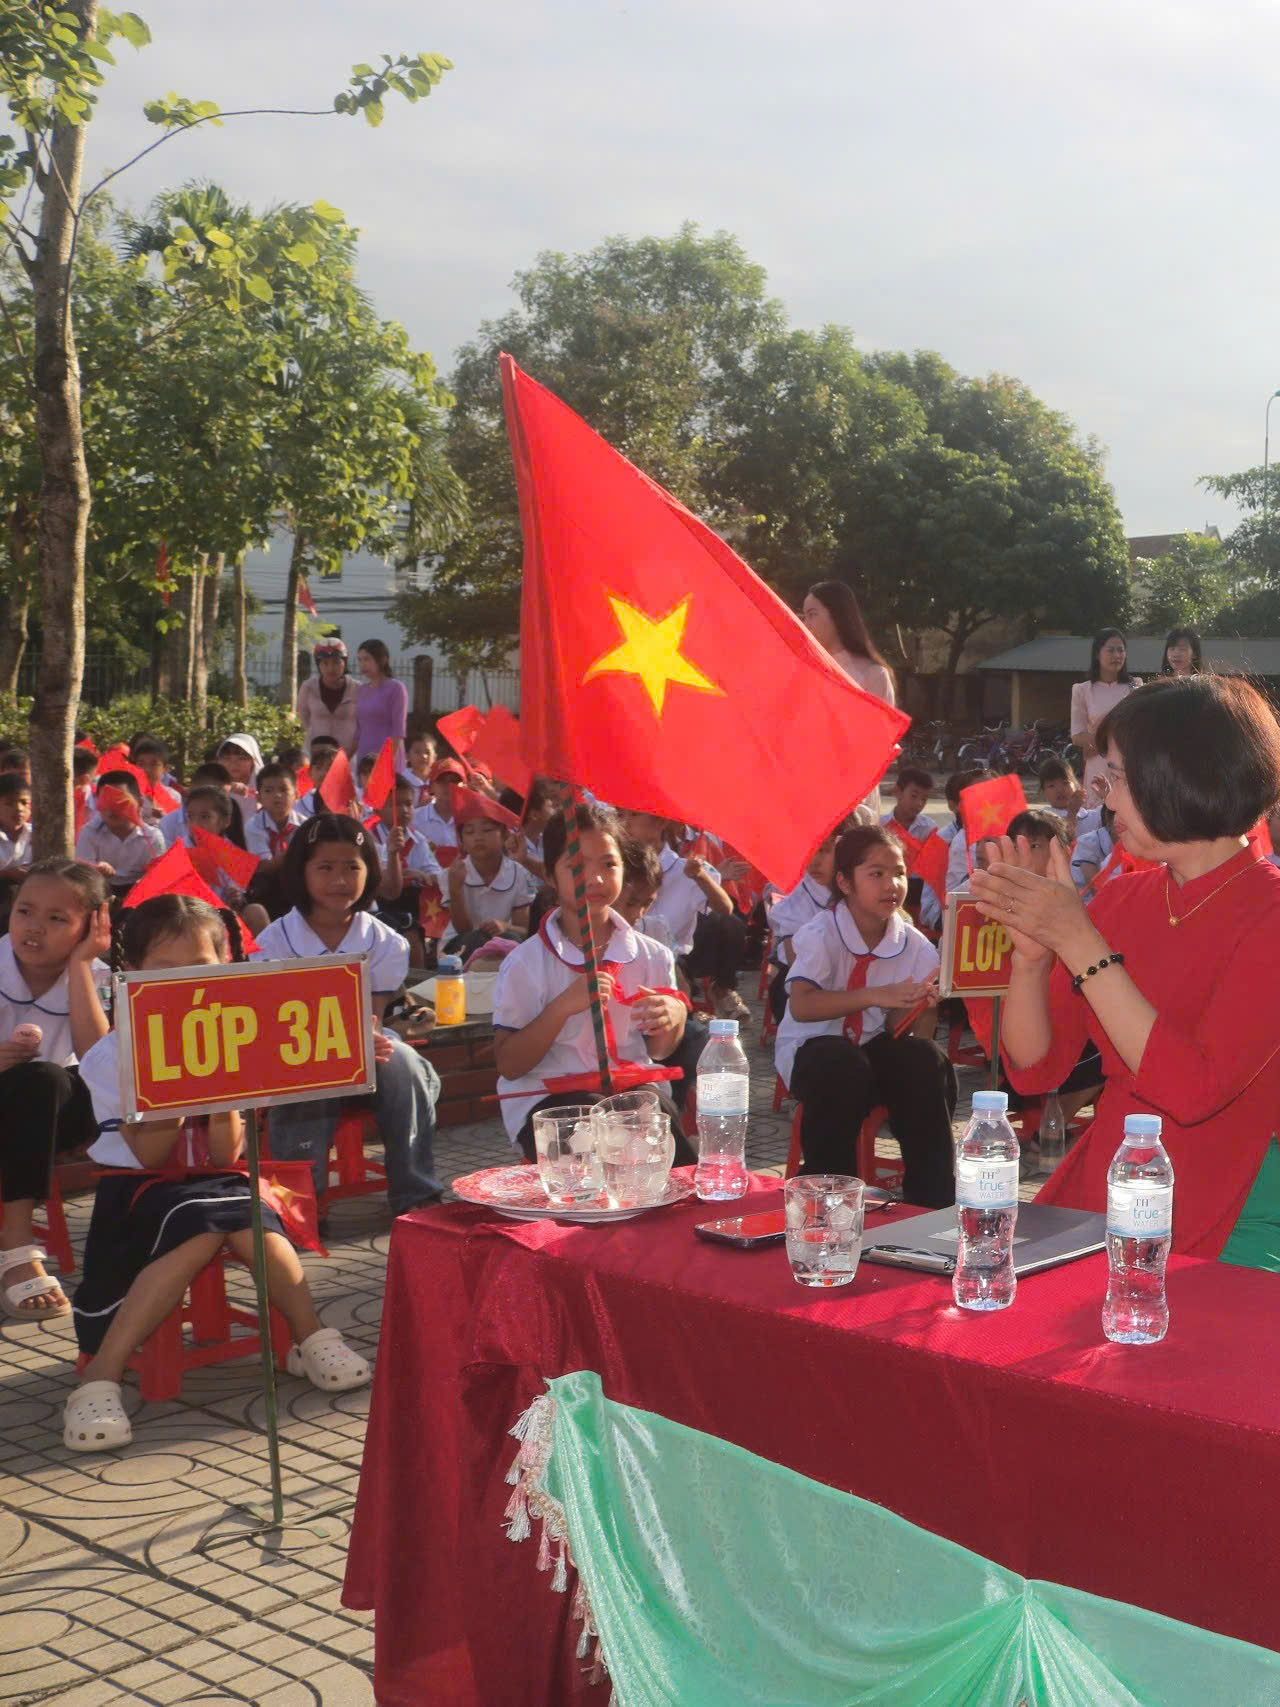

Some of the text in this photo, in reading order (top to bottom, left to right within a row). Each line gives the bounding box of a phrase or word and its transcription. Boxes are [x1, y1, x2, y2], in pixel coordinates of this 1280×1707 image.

[148, 988, 351, 1082] LỚP 3A
[981, 1171, 995, 1180] TH
[980, 1179, 1004, 1191] true
[1135, 1198, 1150, 1207] TH
[1133, 1207, 1160, 1219] true
